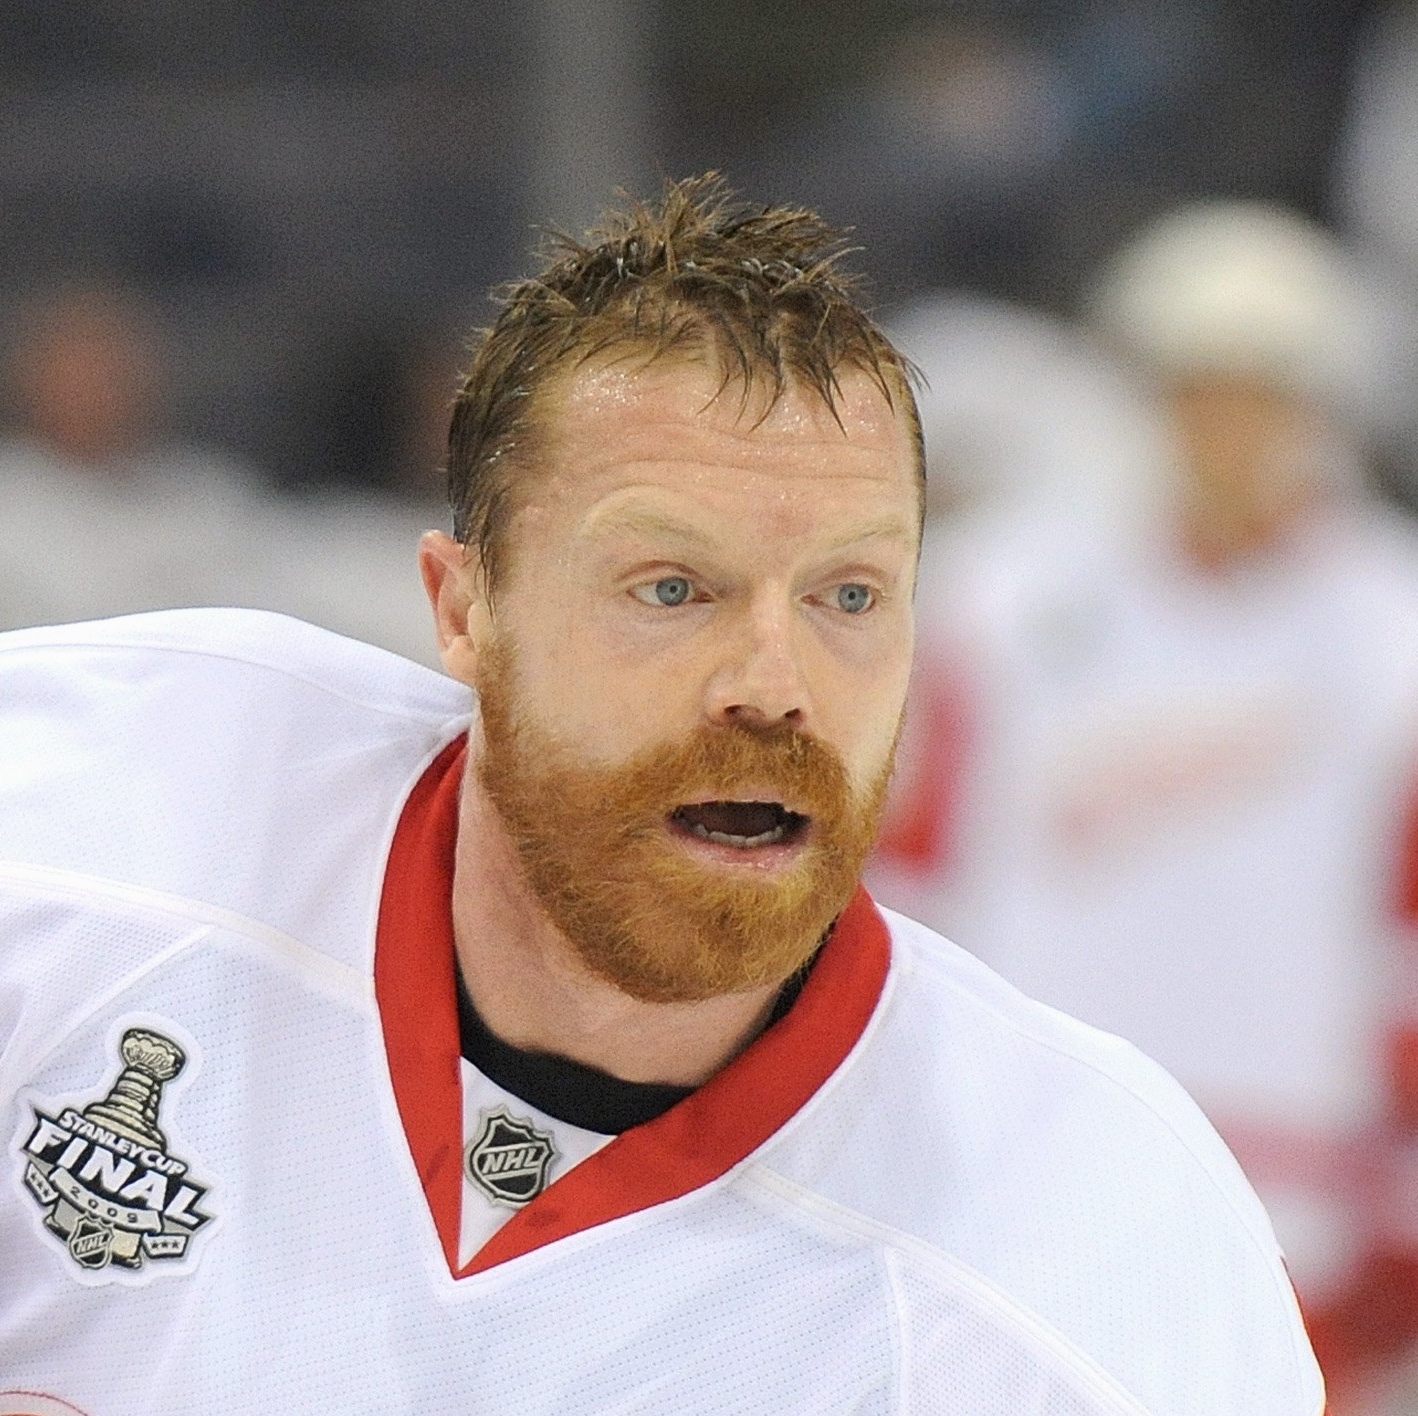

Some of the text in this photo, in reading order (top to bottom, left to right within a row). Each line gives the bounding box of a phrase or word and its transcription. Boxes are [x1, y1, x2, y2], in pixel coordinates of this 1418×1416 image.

[58, 1109, 187, 1176] STANLEY CUP
[481, 1148, 544, 1174] NHL
[28, 1117, 200, 1225] FINAL
[70, 1186, 139, 1224] 2009
